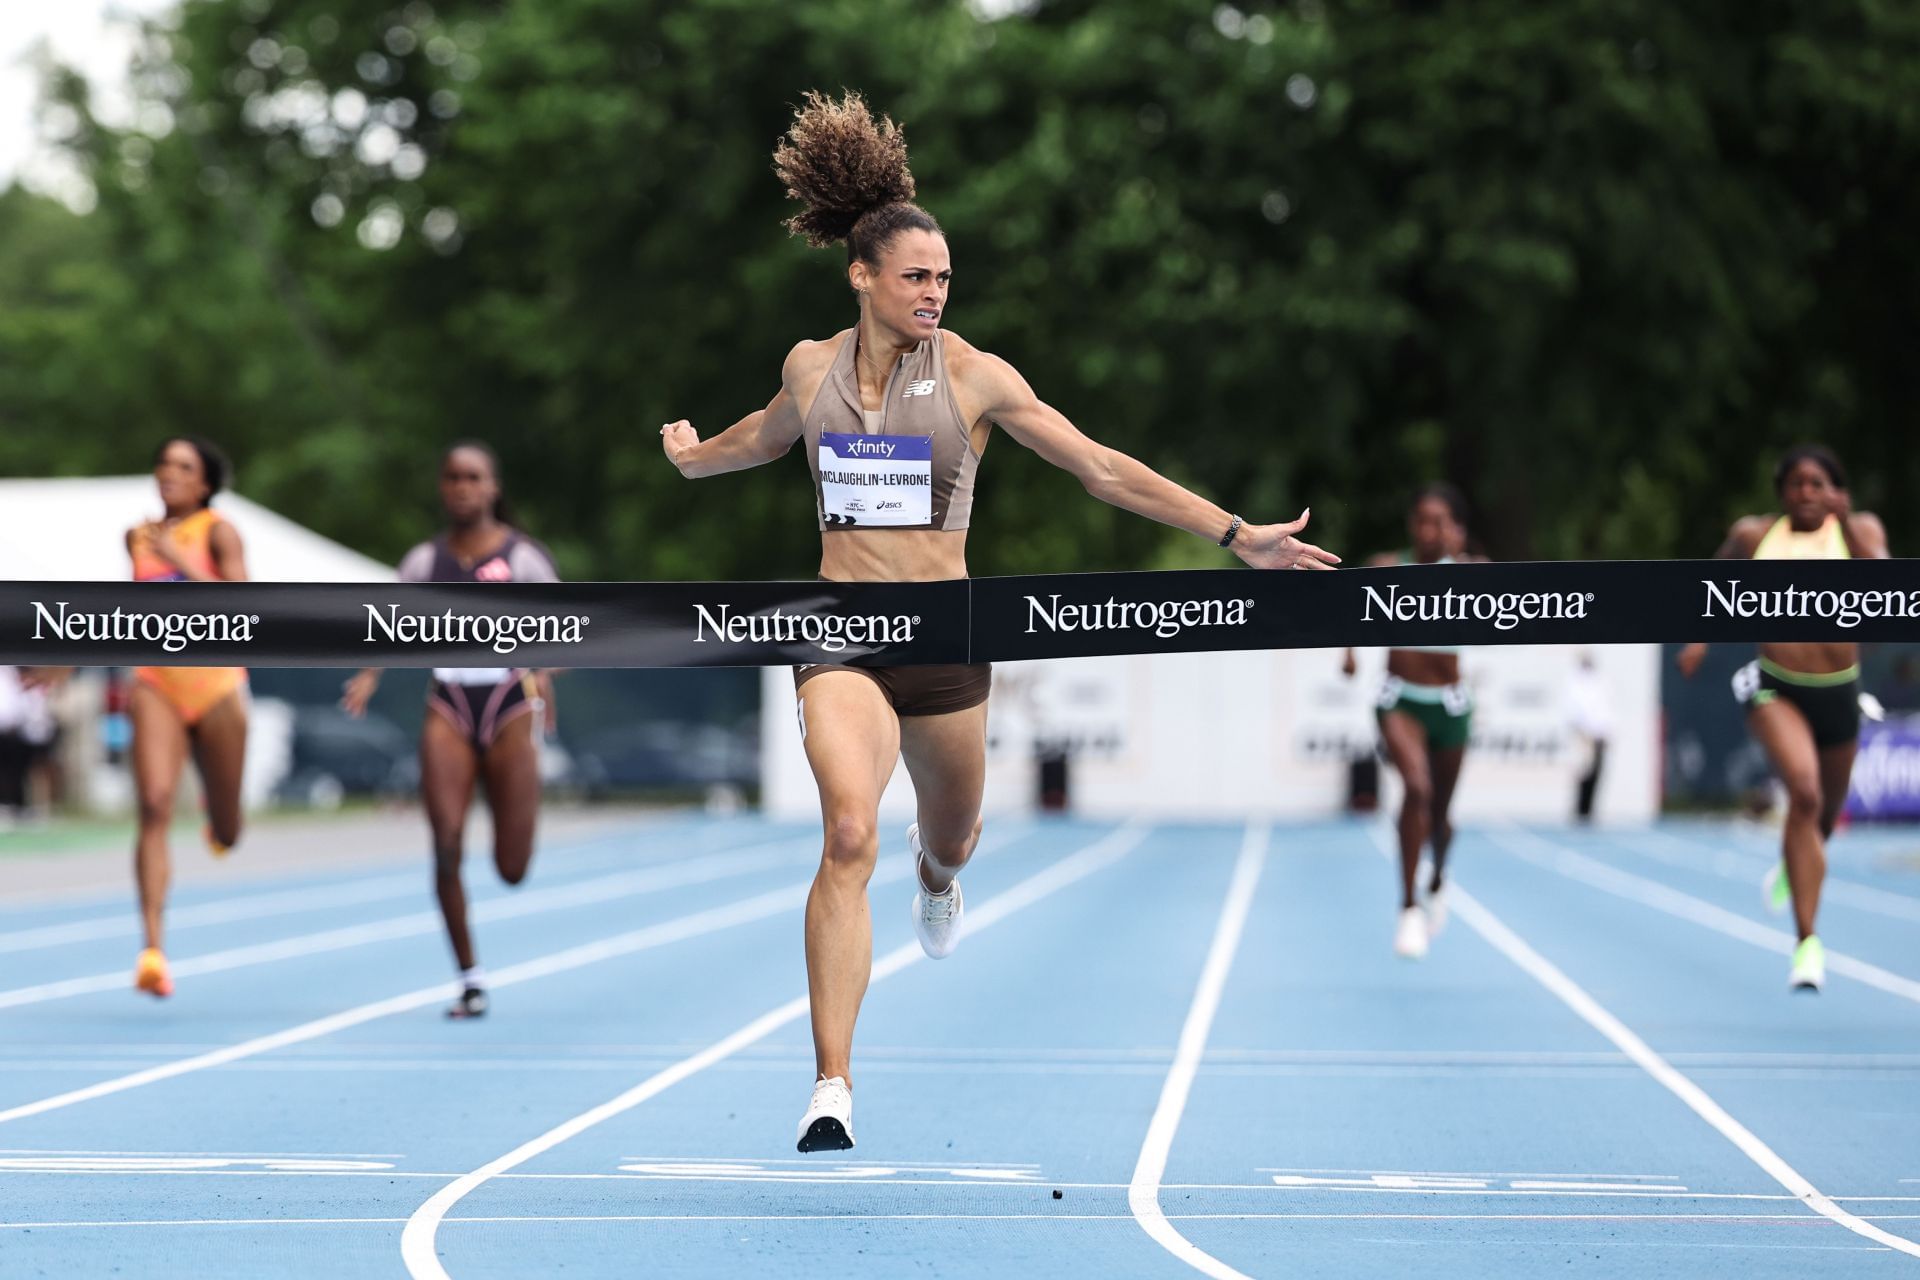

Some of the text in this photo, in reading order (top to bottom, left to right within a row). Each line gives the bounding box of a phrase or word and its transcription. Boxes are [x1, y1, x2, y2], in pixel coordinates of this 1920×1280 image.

[847, 439, 896, 458] xfinity
[820, 470, 931, 486] MCLAUGHLIN-LEVRONE
[884, 501, 903, 509] asics
